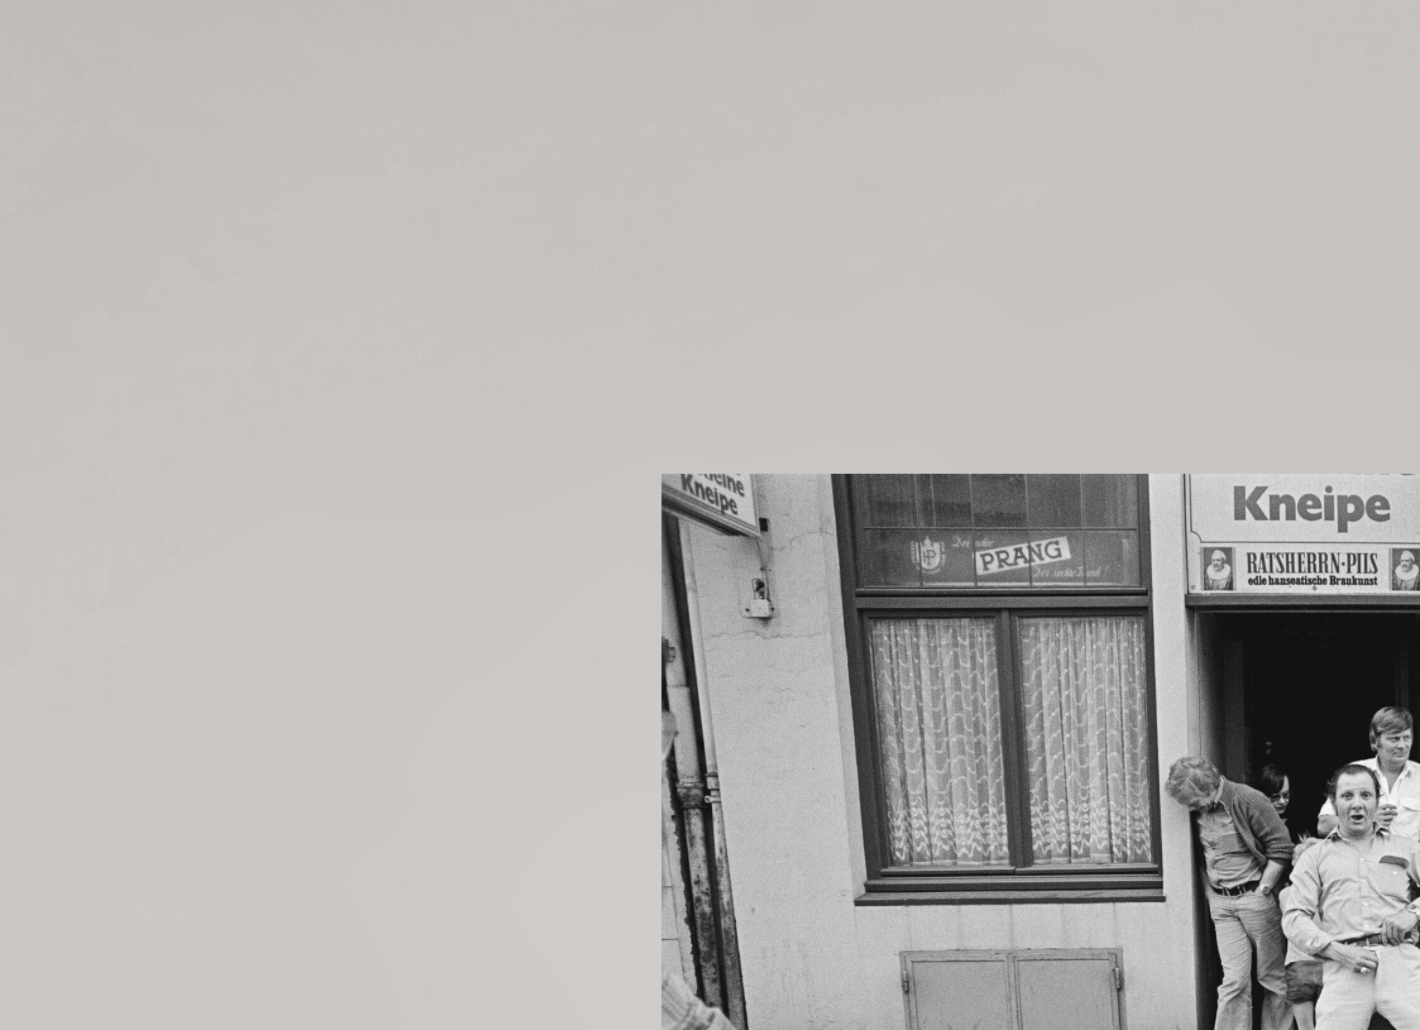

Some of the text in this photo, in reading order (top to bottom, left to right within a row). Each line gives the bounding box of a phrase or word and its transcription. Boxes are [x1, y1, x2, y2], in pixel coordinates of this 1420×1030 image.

[681, 474, 739, 515] Kneipe
[698, 474, 745, 497] eine
[1234, 485, 1391, 533] Kneipe
[979, 540, 1062, 571] PRANG
[1248, 576, 1378, 585] edle hanseatische Braukunst
